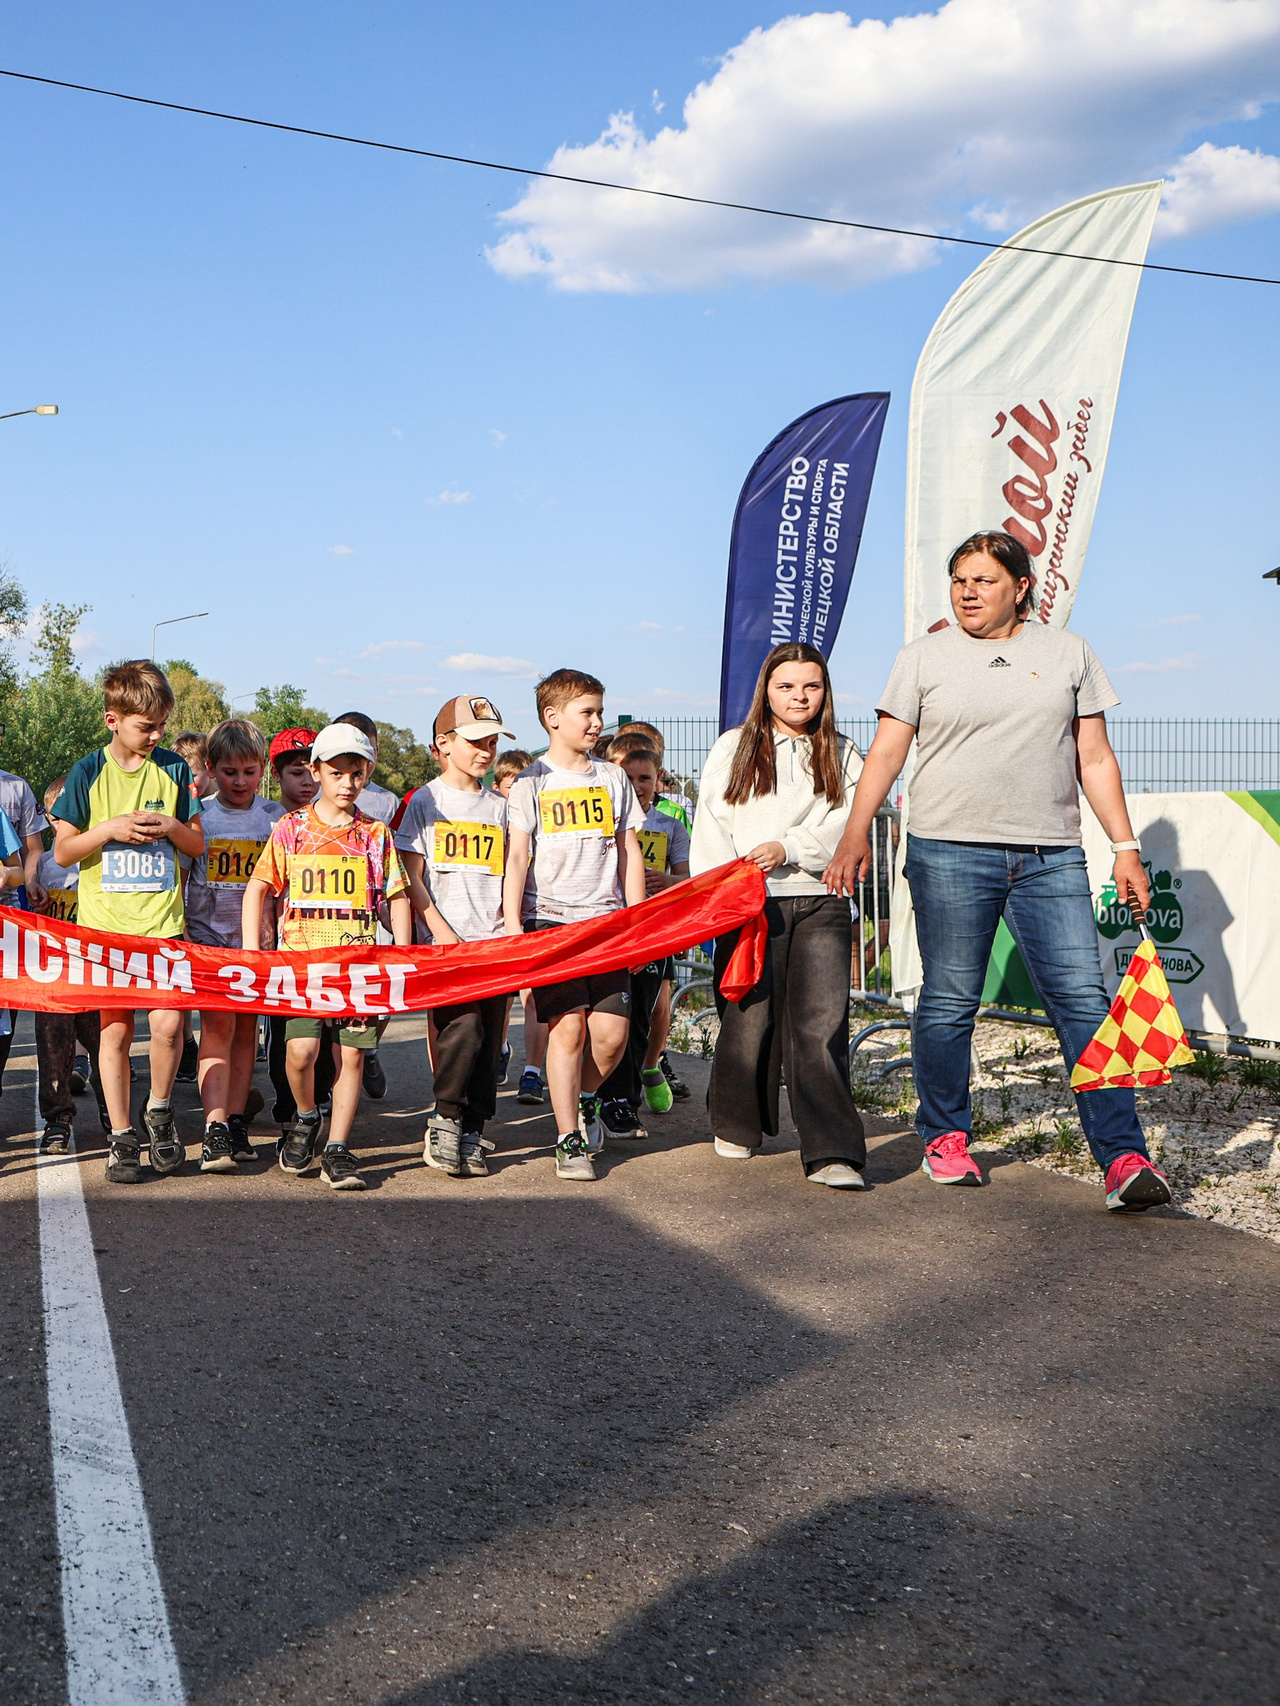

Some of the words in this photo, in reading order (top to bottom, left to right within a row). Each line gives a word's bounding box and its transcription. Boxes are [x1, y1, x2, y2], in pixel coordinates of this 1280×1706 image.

[1067, 397, 1094, 473] забег
[811, 458, 829, 504] СПОРТА
[809, 506, 821, 515] И
[822, 463, 850, 554] ОБЛАСТИ
[804, 517, 819, 578] КУЛЬТУРЫ
[798, 579, 814, 644] ЗИЧЕСКОЙ
[812, 557, 836, 652] ИПЕЦКОЙ
[552, 798, 604, 826] 0115
[113, 851, 166, 878] 3083
[218, 851, 262, 878] 016
[445, 833, 494, 860] 0117
[302, 868, 355, 895] 0110
[218, 963, 418, 1013] ЗАБЕГ
